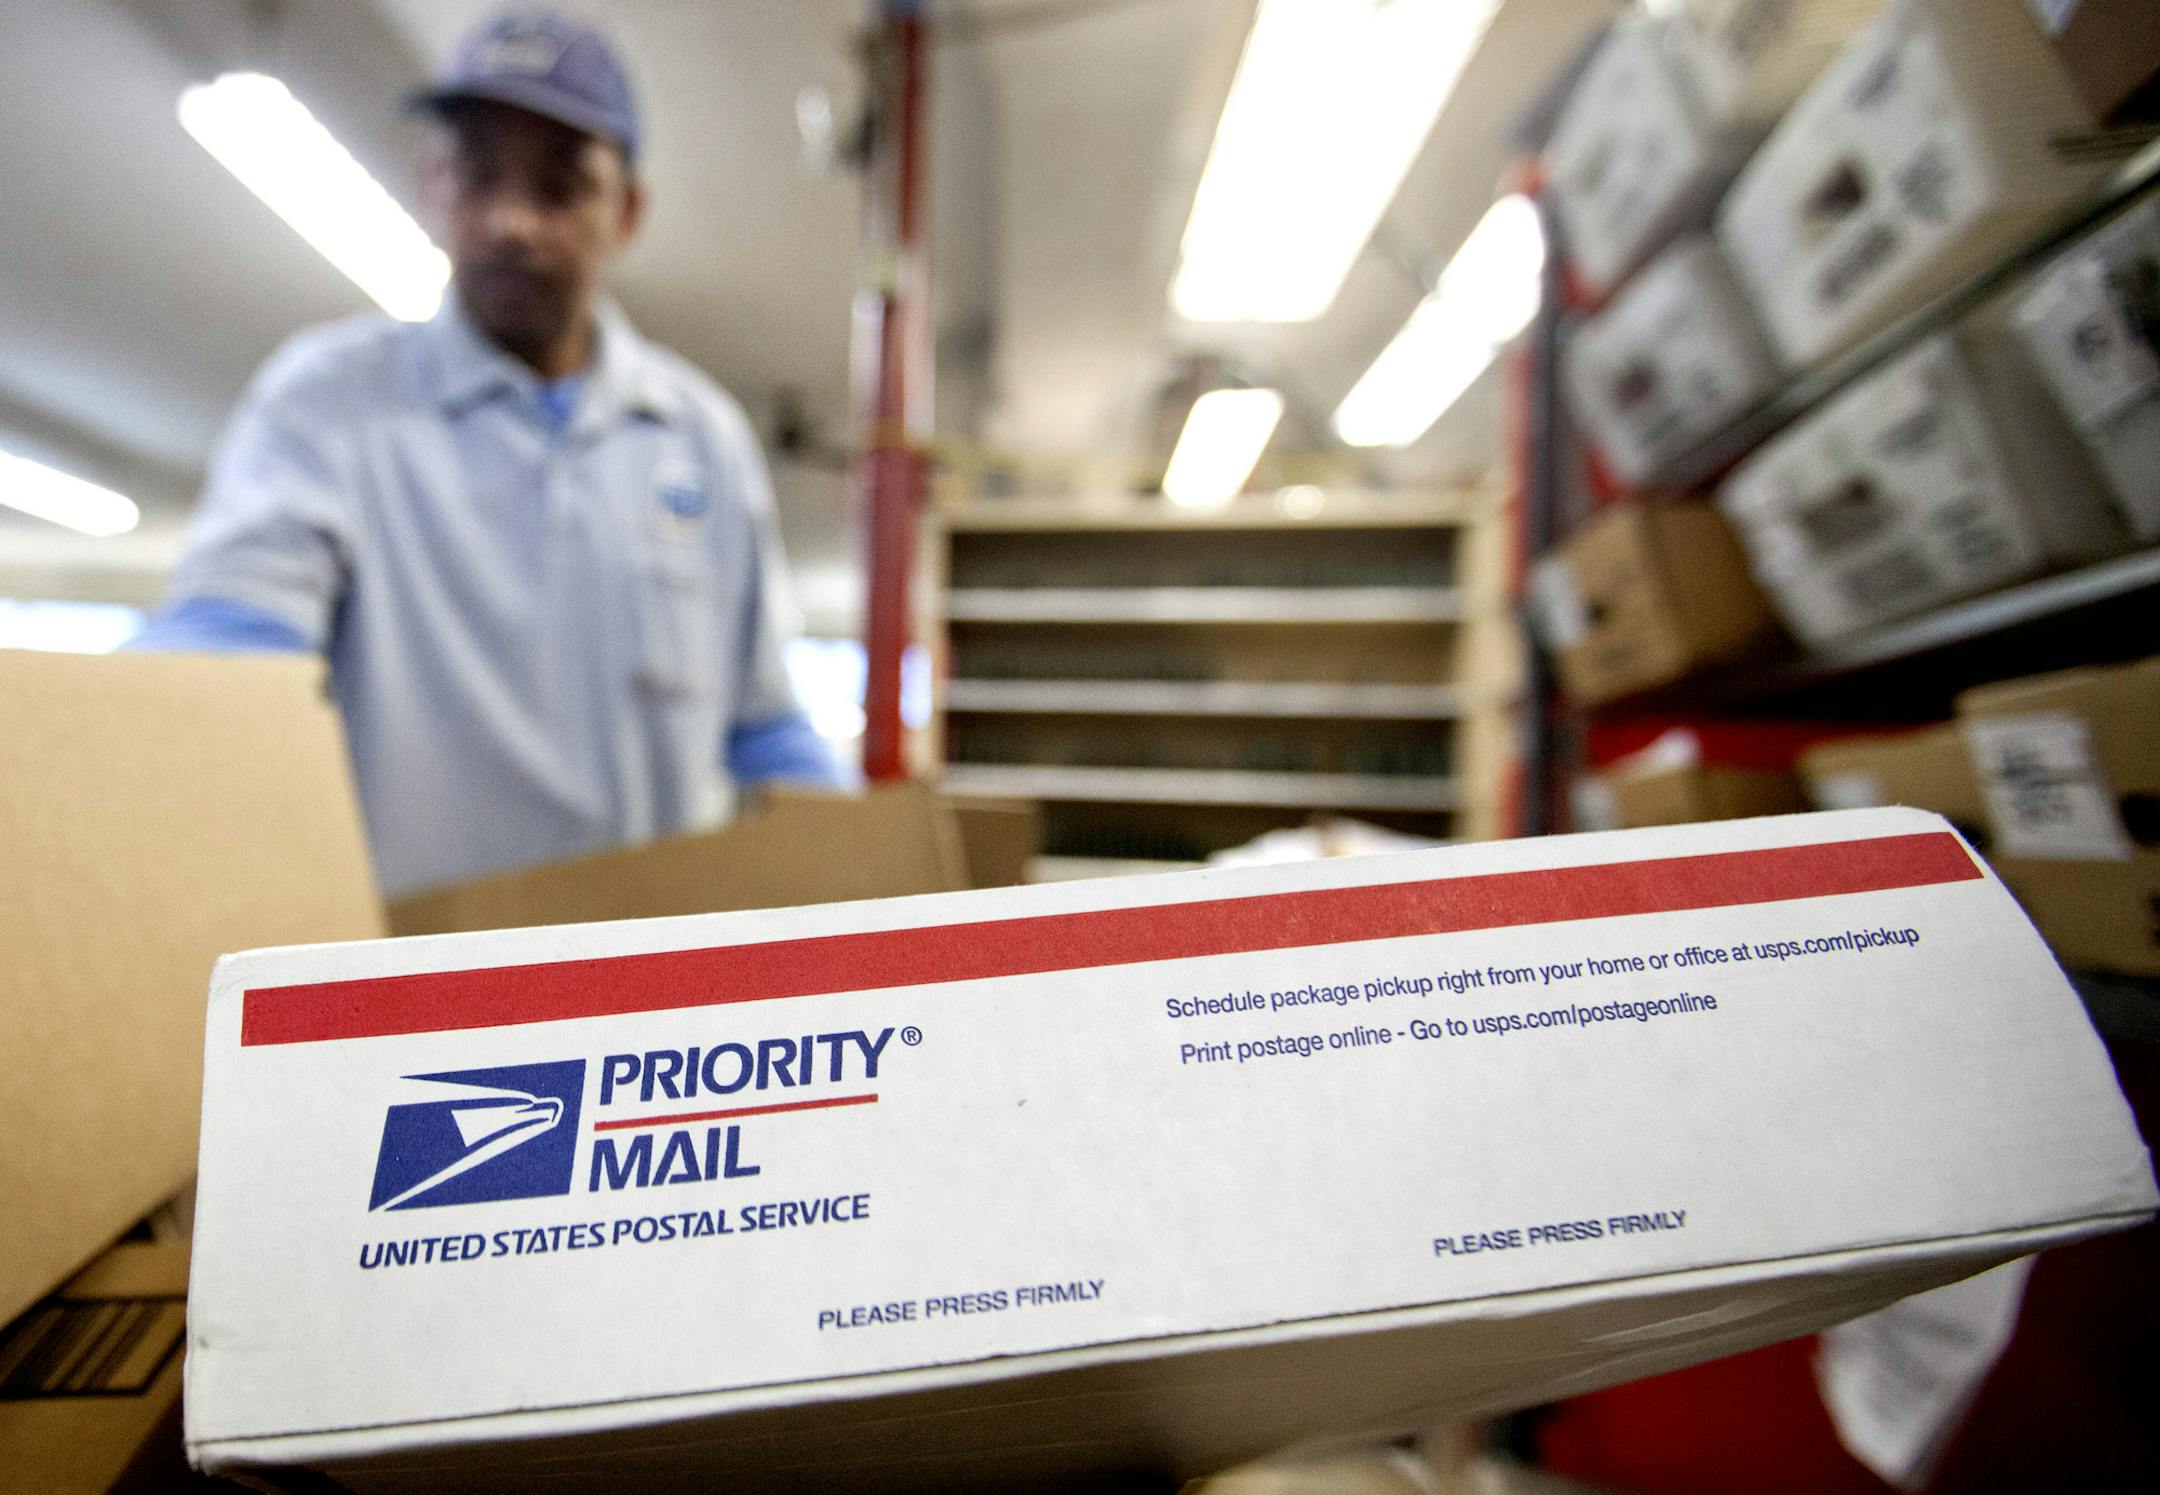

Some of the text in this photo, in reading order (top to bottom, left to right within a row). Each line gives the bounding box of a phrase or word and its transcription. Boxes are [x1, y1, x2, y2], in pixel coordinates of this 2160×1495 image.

[1165, 926, 1921, 1019] Schedule package pickup right from your home or office at usps.com/pickup
[1180, 1040, 1233, 1065] Print
[1237, 1034, 1325, 1064] postage
[1328, 1025, 1392, 1050] online
[1409, 1019, 1443, 1041] Go
[1445, 1017, 1469, 1037] to
[1472, 991, 1718, 1037] usps.com/postageonline
[588, 1125, 762, 1193] MAIL
[359, 1193, 872, 1270] UNITED STATES POSTAL SERVICE
[1433, 1210, 1687, 1257] PLEASE PRESS FIRMLY
[818, 1279, 1105, 1330] PLEASE PRESS FIRMLY
